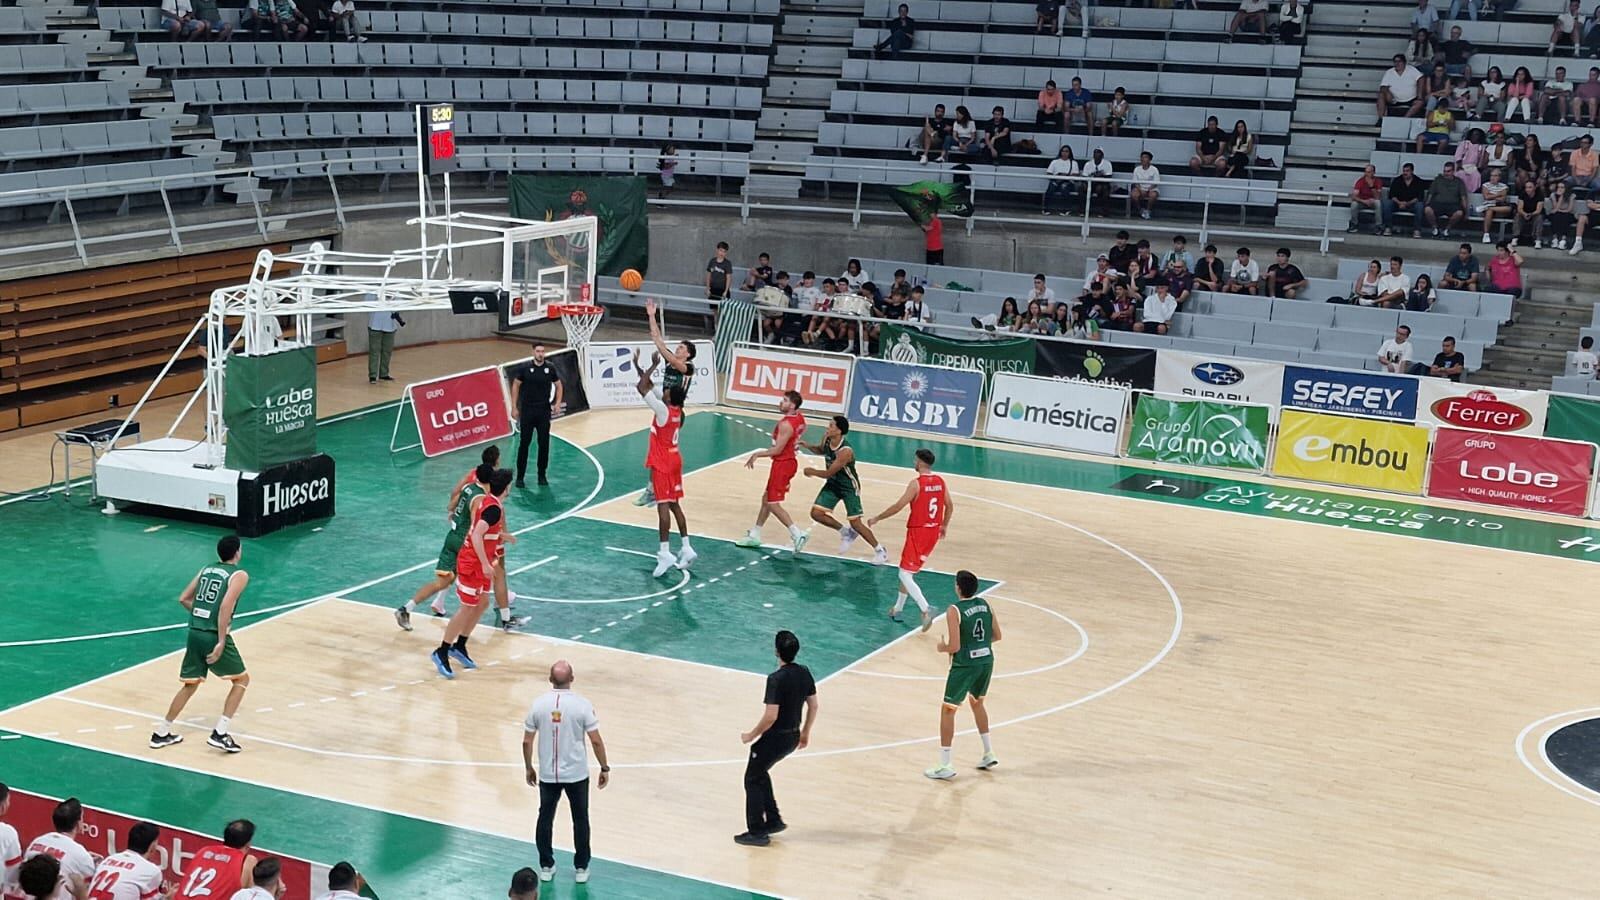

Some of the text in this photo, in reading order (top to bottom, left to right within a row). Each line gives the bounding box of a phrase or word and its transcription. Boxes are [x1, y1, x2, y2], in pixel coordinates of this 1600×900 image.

[432, 108, 452, 121] 5:30
[740, 363, 838, 397] UNITIC
[266, 387, 313, 409] Lobe
[426, 388, 444, 399] GRUPO
[1182, 388, 1250, 402] SUBARU
[1293, 380, 1403, 410] SERFEY
[265, 403, 313, 426] Huesca
[430, 401, 489, 429] Lobe
[859, 394, 966, 429] GASBY
[1371, 409, 1402, 417] PISCINAS
[1446, 401, 1520, 426] Ferrer
[1145, 417, 1191, 433] Grupo
[1293, 435, 1408, 471] embou
[1465, 439, 1496, 450] GRUPO
[1460, 460, 1560, 489] Lobe
[263, 477, 329, 516] Huesca
[928, 497, 938, 519] 5
[1215, 485, 1504, 531] Ayuntamiento
[1468, 487, 1547, 504] HIGH QUALITY HOMES
[1203, 493, 1425, 530] de Huesca
[196, 577, 222, 603] 15
[973, 618, 984, 642] 4
[88, 871, 121, 900] 22
[183, 866, 216, 897] 12
